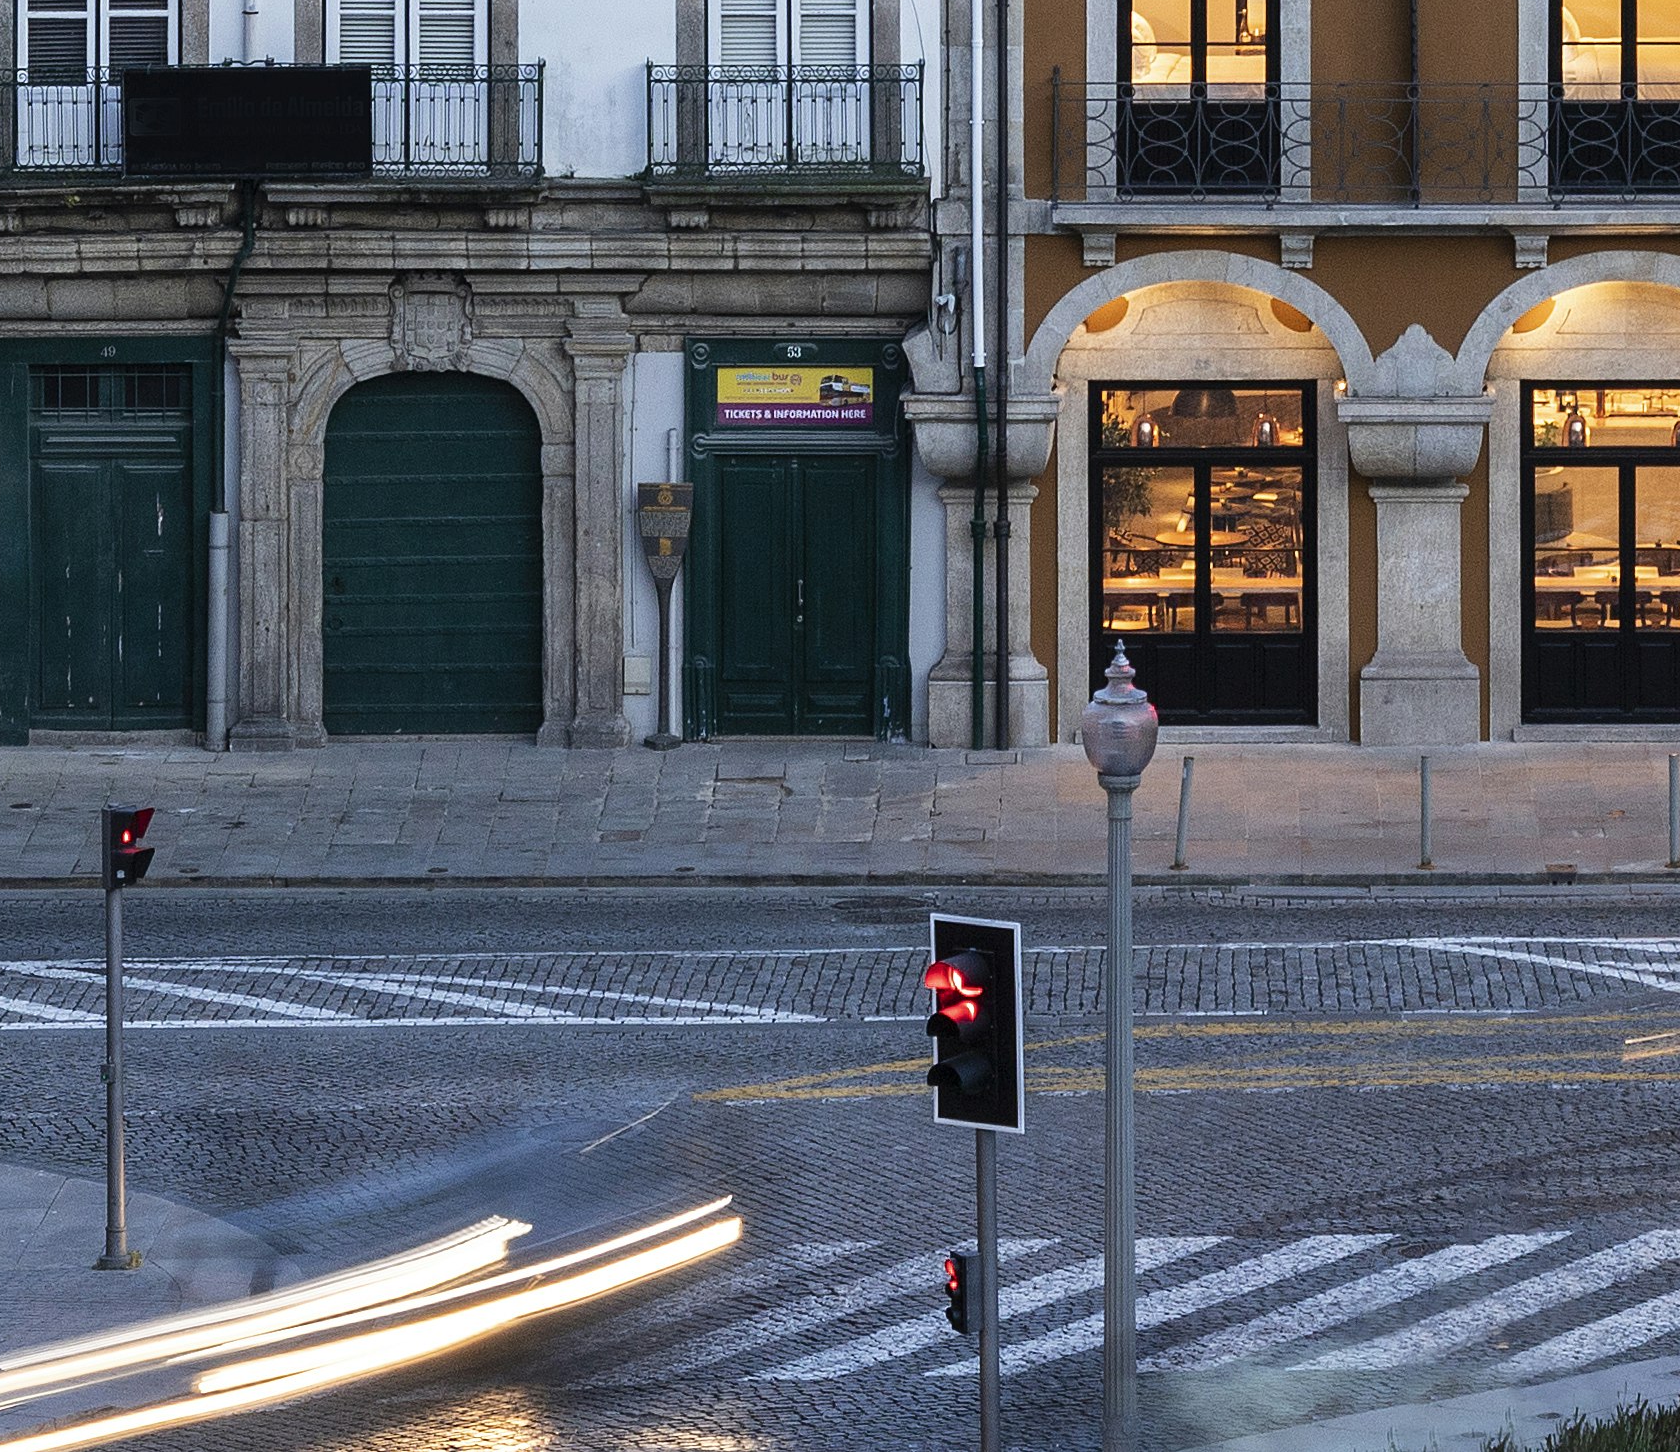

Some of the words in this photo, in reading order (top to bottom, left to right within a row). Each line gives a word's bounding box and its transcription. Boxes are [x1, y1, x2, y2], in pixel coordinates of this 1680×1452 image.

[260, 96, 283, 118] de
[287, 96, 365, 118] Almeida
[100, 345, 116, 357] 49
[787, 345, 801, 358] 53
[724, 409, 761, 419] TICKETS
[764, 409, 771, 419] &
[774, 409, 838, 419] INFORMATION
[841, 409, 866, 418] HERE
